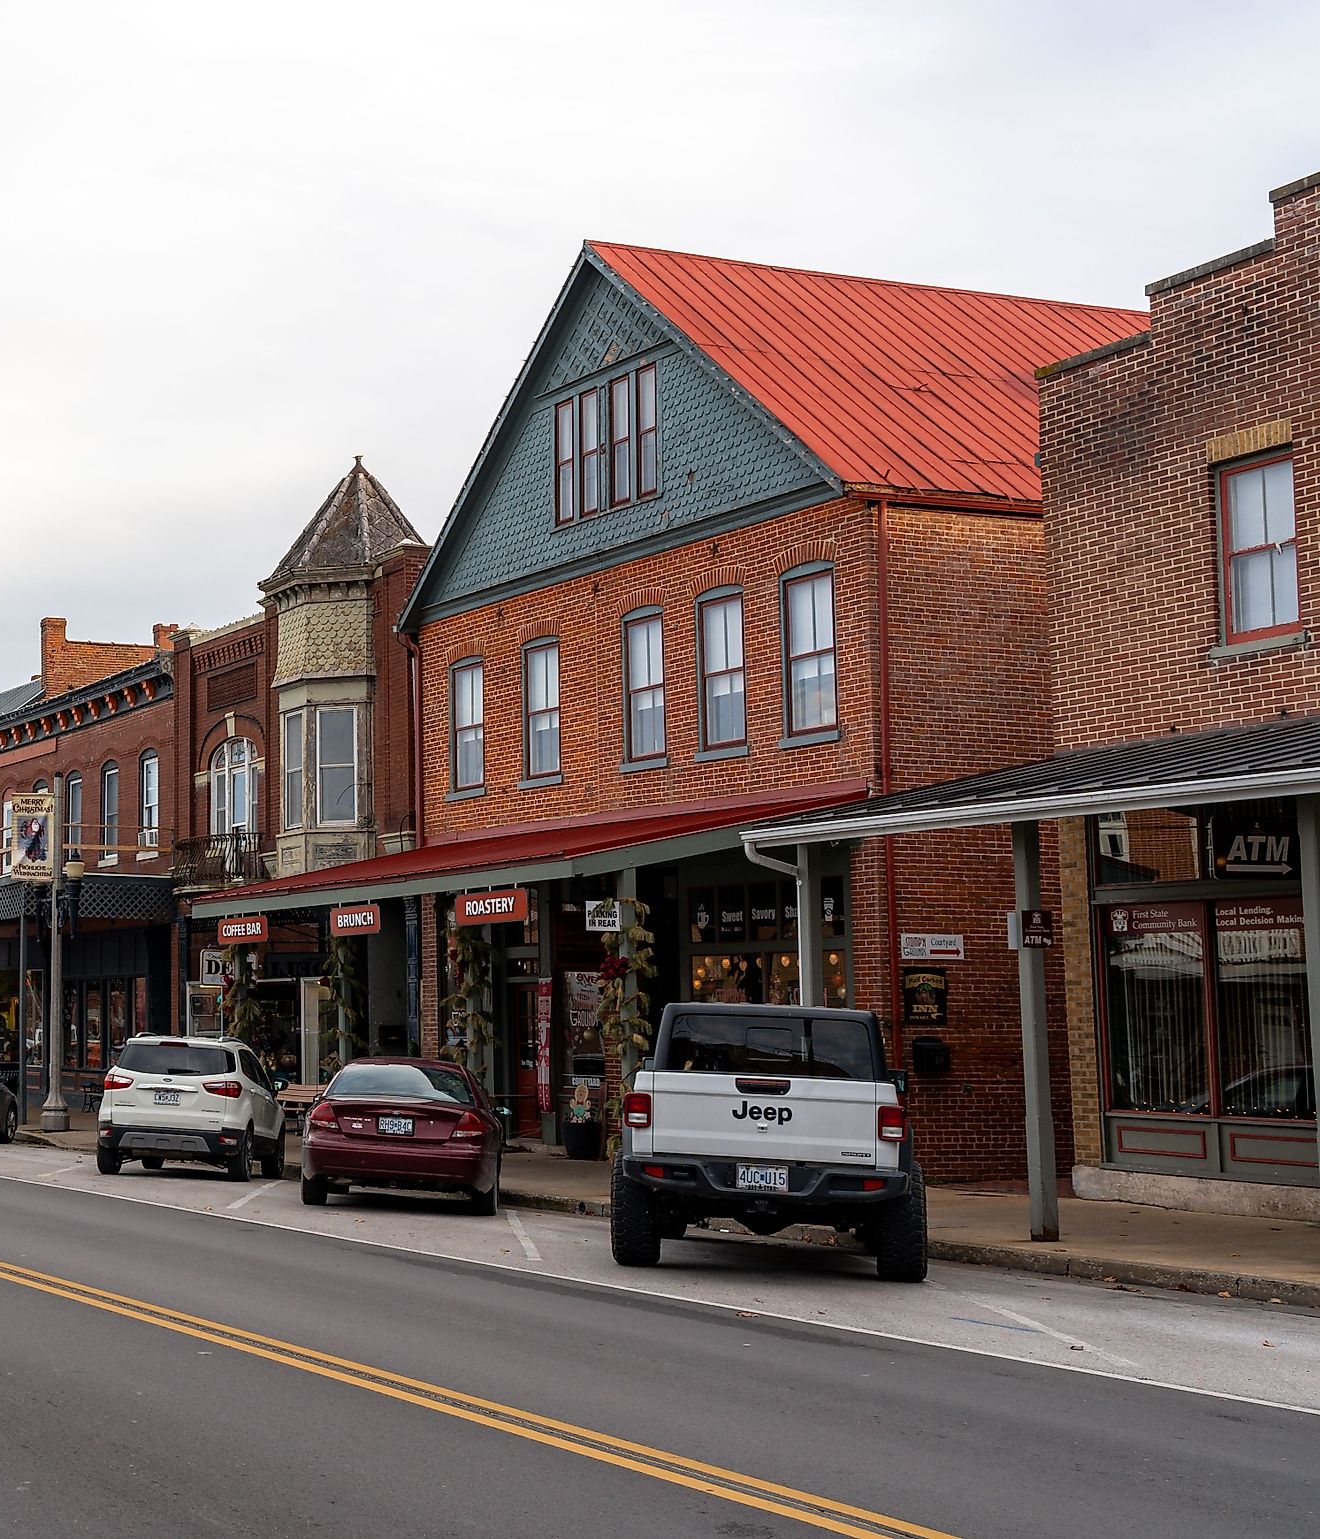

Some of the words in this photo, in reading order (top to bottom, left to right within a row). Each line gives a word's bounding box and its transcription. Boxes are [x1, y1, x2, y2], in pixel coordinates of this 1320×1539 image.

[20, 798, 46, 807] MERRY
[1227, 835, 1290, 862] ATM
[465, 896, 515, 916] ROASTERY
[1215, 907, 1237, 916] Local
[1238, 905, 1274, 916] Lending.
[337, 911, 374, 928] BRUNCH
[587, 909, 618, 920] PKING
[721, 910, 744, 923] Sweet
[751, 908, 776, 921] Savory
[1132, 910, 1149, 919] First
[1149, 909, 1169, 919] State
[588, 919, 597, 928] IN
[598, 919, 618, 928] REAR
[1132, 920, 1177, 931] Community
[1177, 917, 1198, 927] Bank
[1215, 916, 1237, 927] Local
[1239, 915, 1275, 926] Decision
[222, 923, 246, 937] COFFEE
[246, 921, 262, 936] BAR
[930, 937, 957, 948] Courtyard
[1024, 935, 1042, 945] ATM
[911, 1004, 939, 1013] INN
[732, 1100, 793, 1126] Jeep
